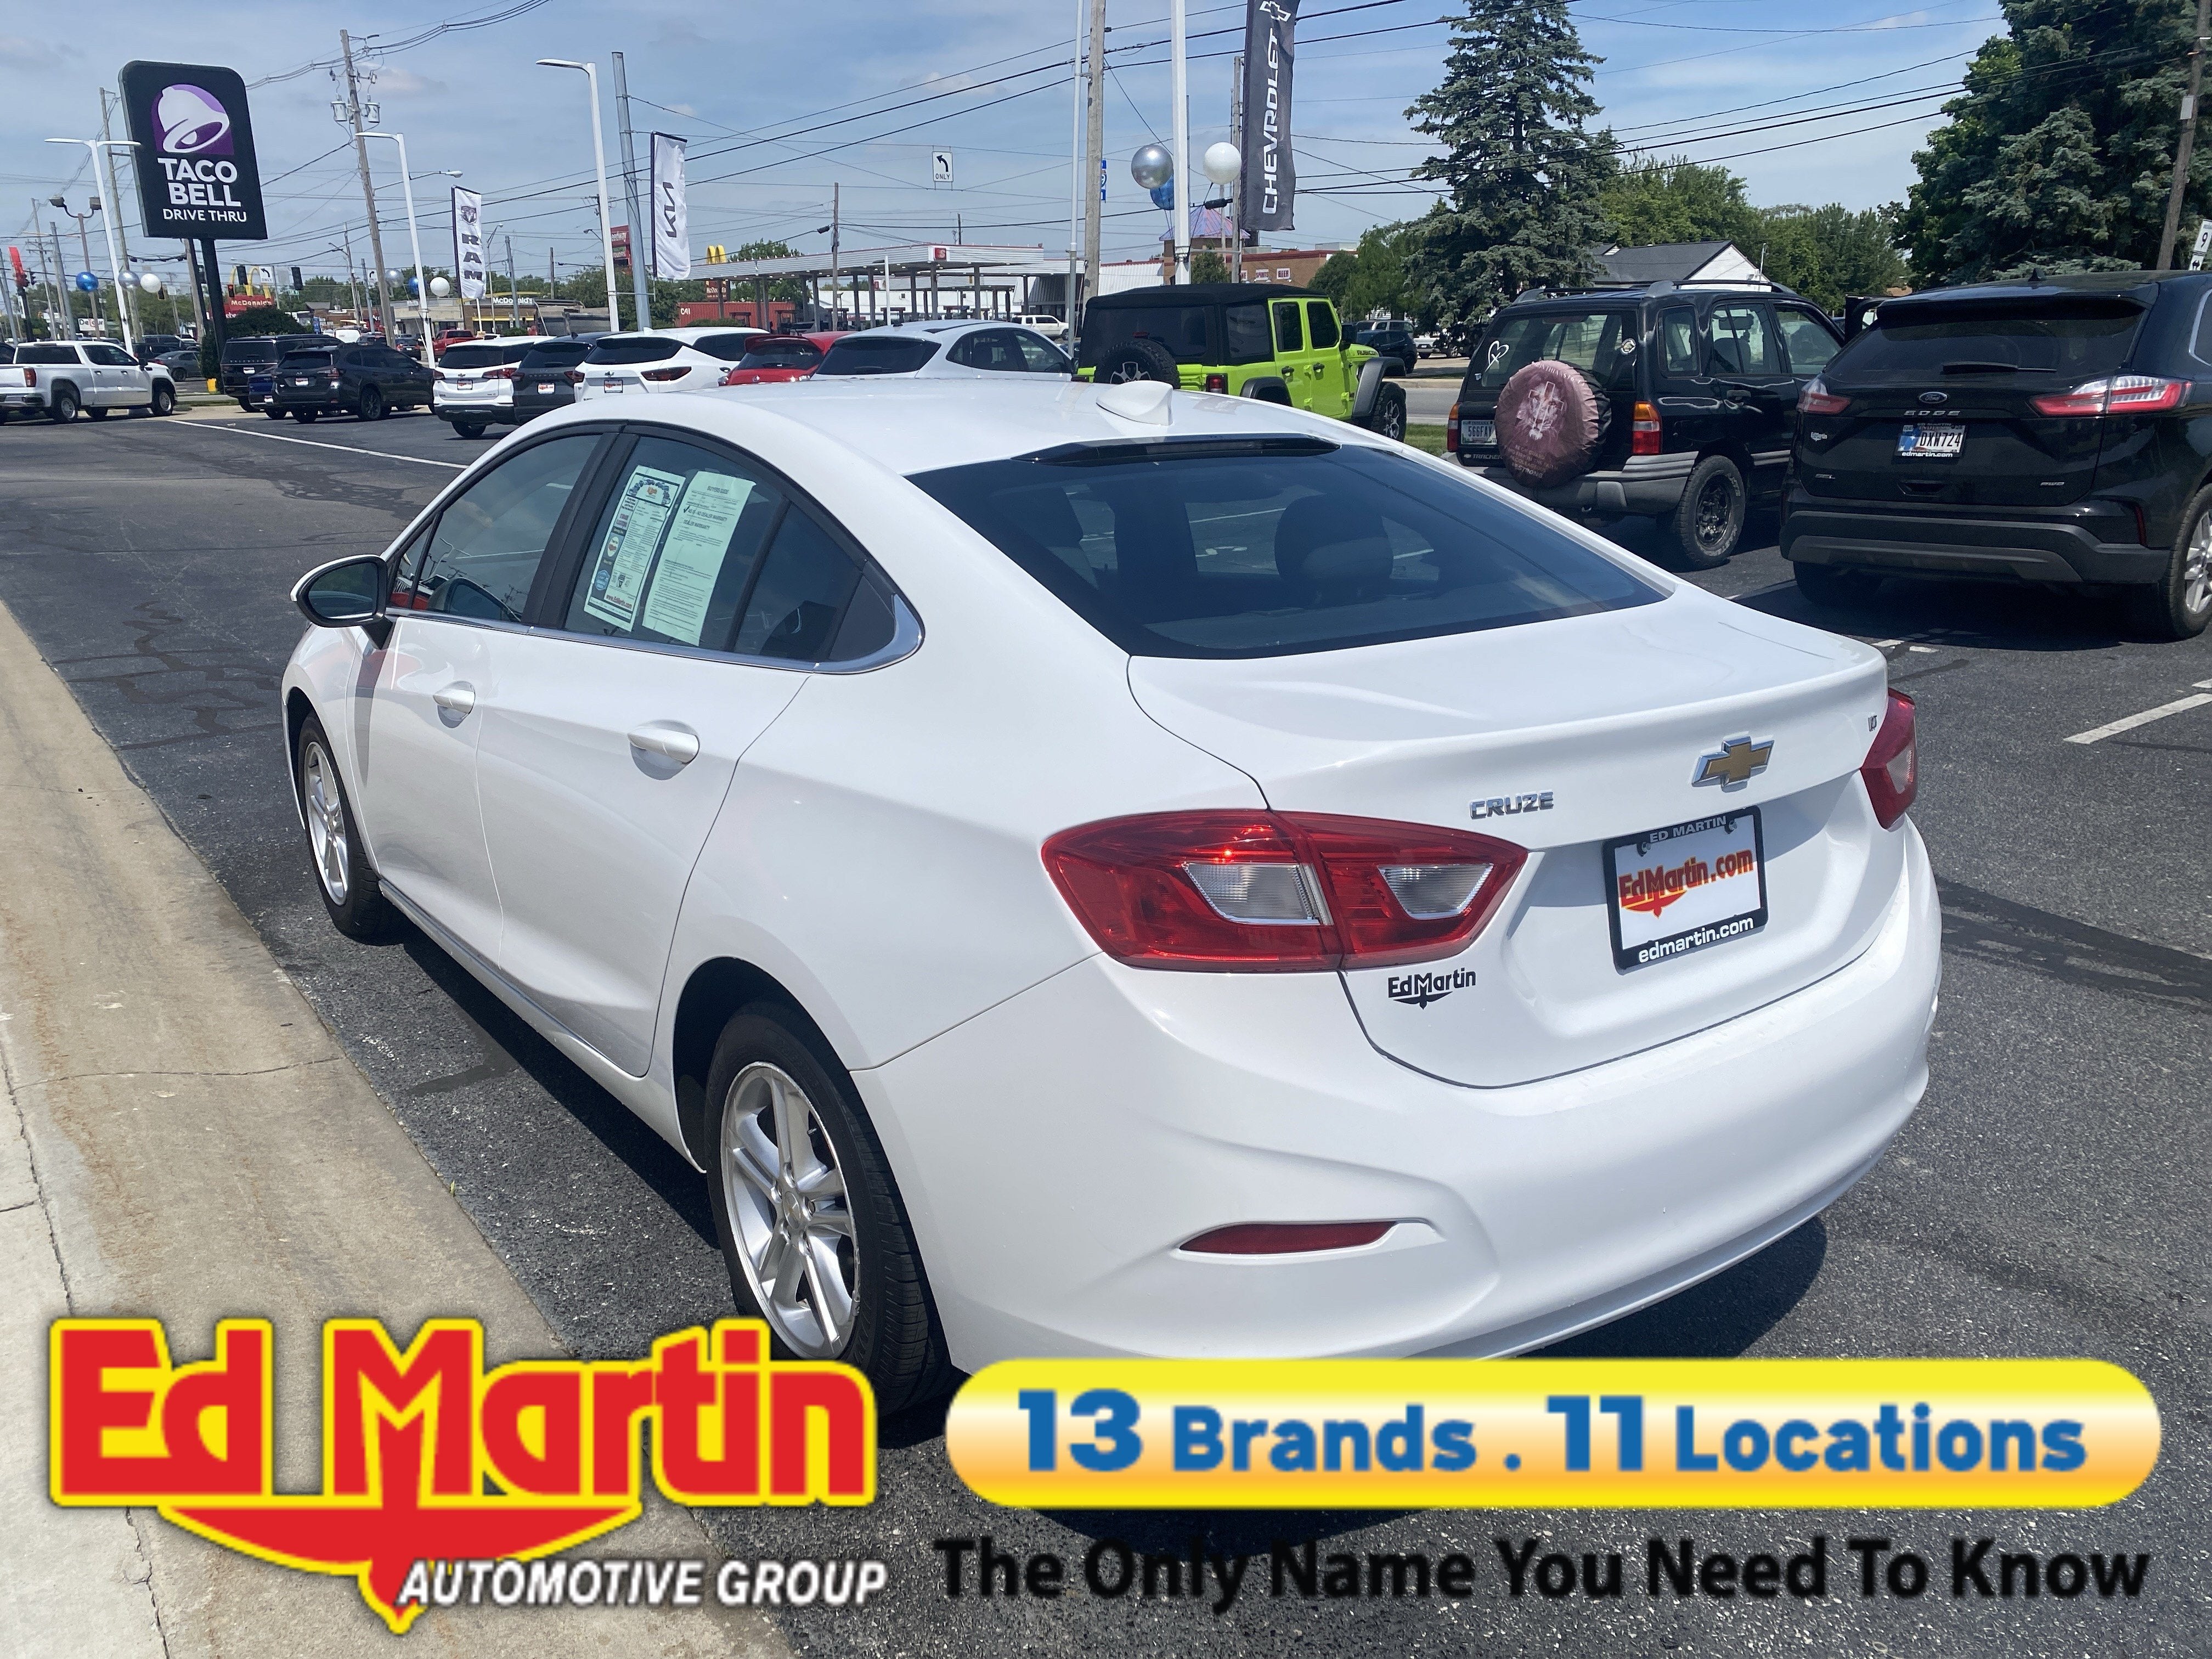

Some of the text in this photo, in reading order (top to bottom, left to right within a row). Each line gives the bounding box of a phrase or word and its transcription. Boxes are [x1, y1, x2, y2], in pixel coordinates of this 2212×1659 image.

[1263, 27, 1279, 214] CHEVROLET
[157, 157, 238, 183] TACO
[168, 182, 241, 207] BELL
[163, 208, 247, 222] DRIVE THRU
[662, 182, 677, 238] KIA
[2200, 232, 2208, 248] 9
[461, 233, 482, 281] RAM
[1468, 426, 1492, 437] 566FAY
[1469, 789, 1555, 820] CRUZE
[1650, 816, 1728, 843] ED MARTIN
[1618, 849, 1754, 911] EdMartin.com
[1639, 917, 1754, 963] edmartin.com
